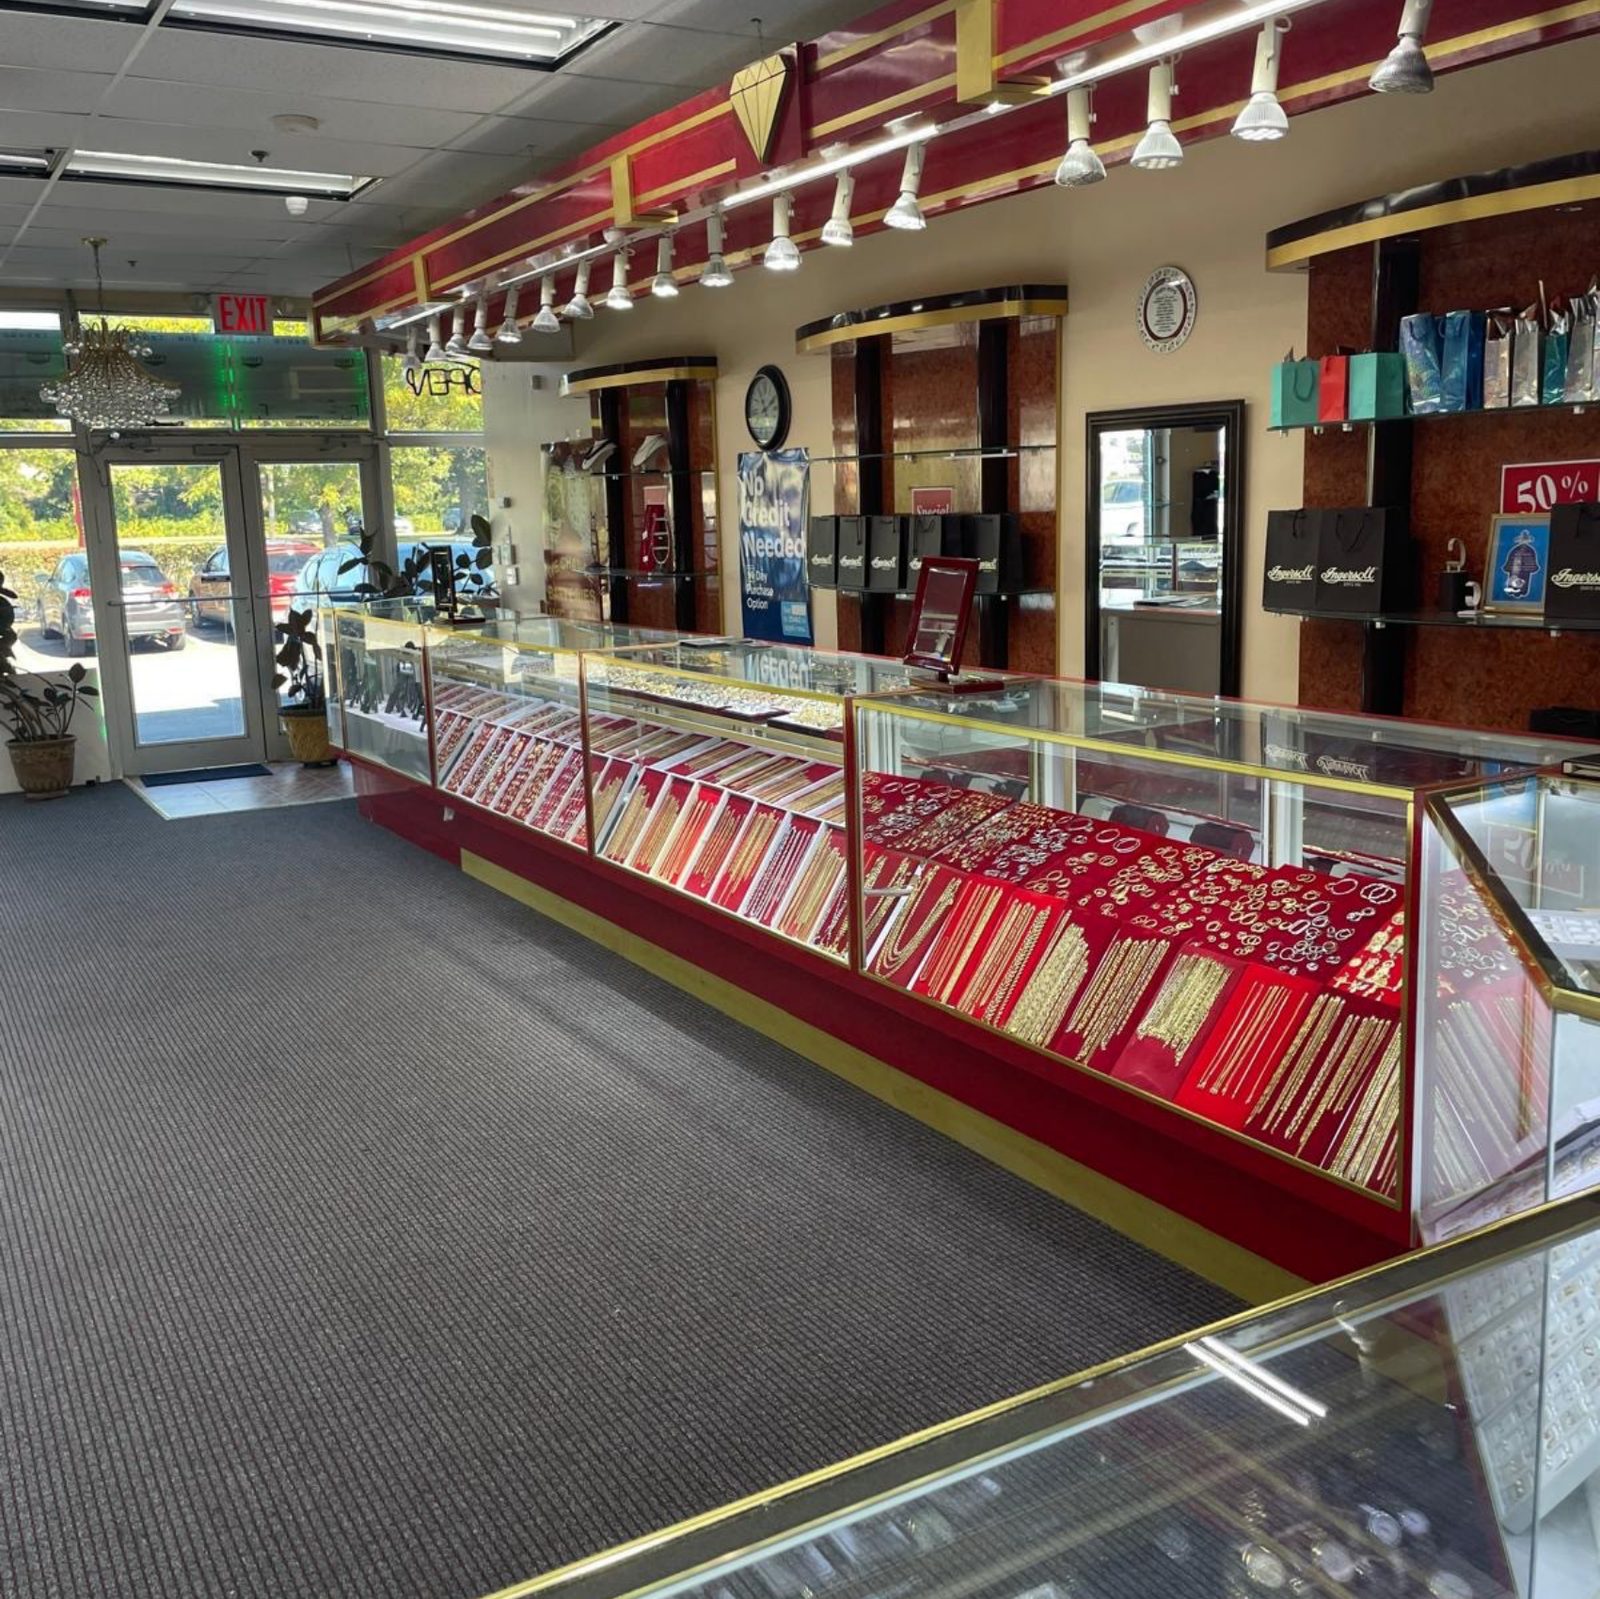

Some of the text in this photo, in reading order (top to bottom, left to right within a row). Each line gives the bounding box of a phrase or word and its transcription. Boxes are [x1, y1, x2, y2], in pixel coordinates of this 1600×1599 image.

[219, 296, 267, 331] EXIT
[742, 470, 764, 496] No
[742, 499, 790, 527] Credit
[743, 530, 806, 558] Needed
[1551, 568, 1600, 588] Ingers
[746, 597, 768, 611] Option
